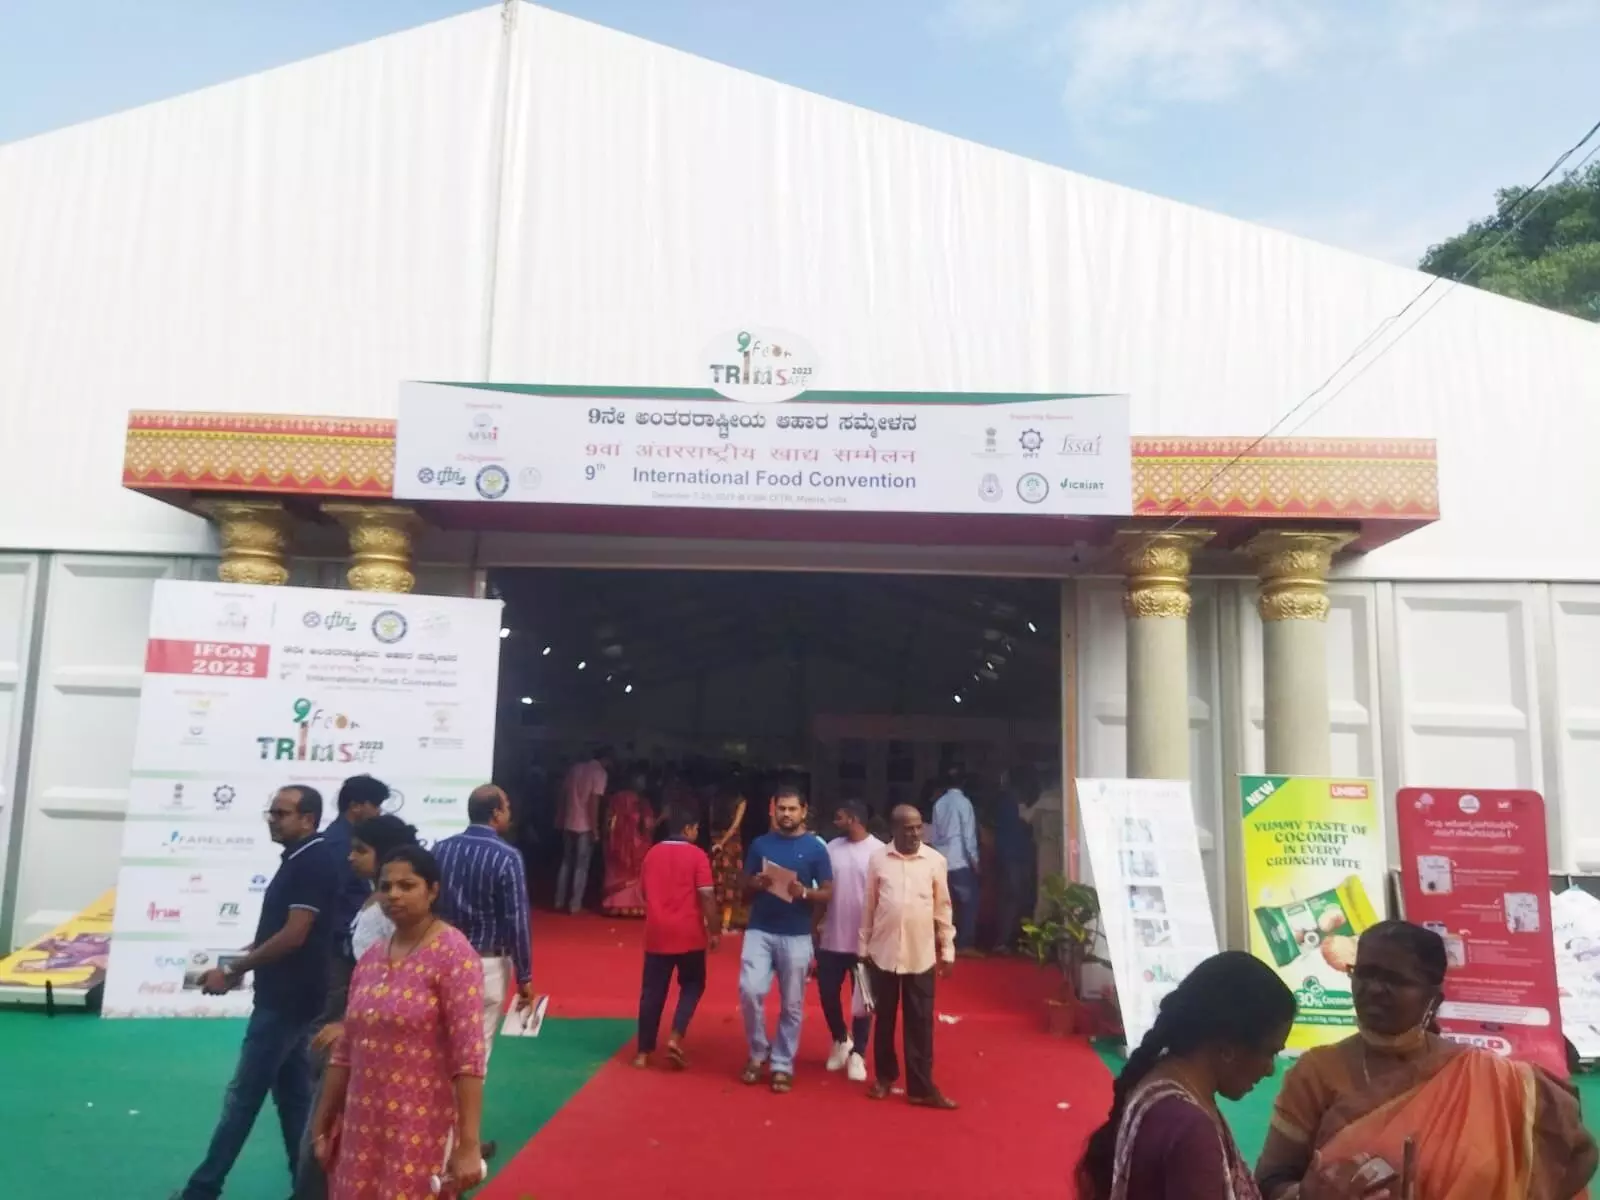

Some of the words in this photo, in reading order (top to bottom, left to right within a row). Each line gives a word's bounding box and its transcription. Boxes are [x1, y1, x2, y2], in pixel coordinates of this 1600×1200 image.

[776, 413, 829, 429] ಆಹಾರ
[839, 412, 917, 438] ಸಮ್ಮೇಳನ
[832, 444, 917, 463] सम्मेलन
[632, 466, 750, 486] International
[755, 470, 803, 487] Food
[809, 471, 916, 489] Convention
[193, 643, 258, 659] IFCoN
[192, 659, 257, 676] 2023
[1245, 780, 1275, 807] NEW
[1306, 821, 1348, 833] TASTE
[1351, 824, 1368, 836] OF
[1274, 832, 1348, 845] COCONUT
[1283, 844, 1296, 854] IN
[1300, 844, 1341, 856] EVERY
[1266, 856, 1328, 867] CRUNCHY
[1332, 858, 1361, 869] BITE
[1296, 991, 1324, 1007] 30%
